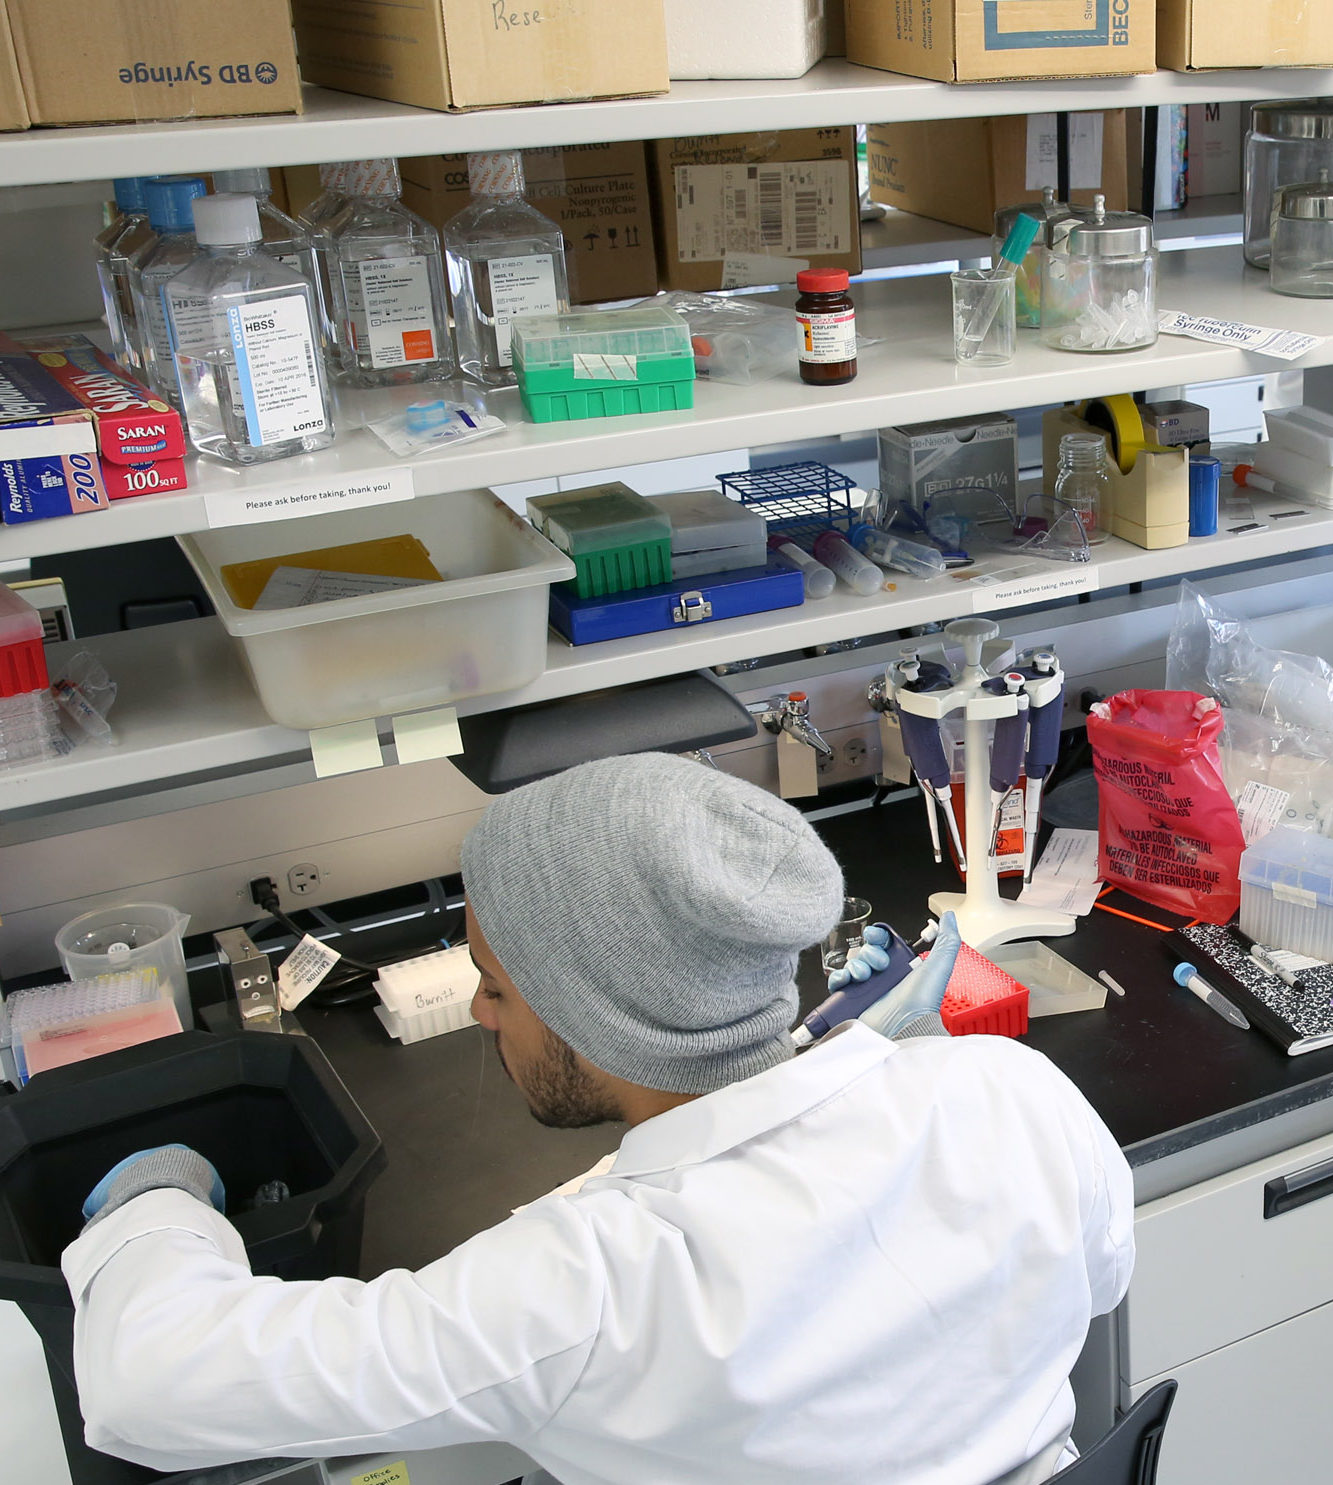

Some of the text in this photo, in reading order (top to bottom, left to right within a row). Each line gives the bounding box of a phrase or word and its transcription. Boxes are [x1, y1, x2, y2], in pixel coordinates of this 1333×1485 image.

[119, 60, 252, 87] BD Syringe
[871, 154, 898, 176] NUNC
[566, 183, 606, 196] Culture
[607, 181, 635, 192] Plate
[569, 193, 637, 208] Nonpyrogenic
[245, 319, 276, 333] HBSS
[1173, 319, 1252, 342] Syringe Only
[69, 372, 149, 413] SARAN
[117, 424, 166, 441] SARAN
[10, 462, 24, 514] Reynolds
[68, 453, 101, 506] 200
[123, 470, 160, 491] 100
[246, 482, 392, 510] Please ask before taking, thank you!
[995, 591, 1012, 599] Please
[1023, 586, 1040, 595] before
[1041, 583, 1058, 592] taking,
[1175, 797, 1194, 808] QUE
[1140, 843, 1150, 855] BE
[1151, 844, 1199, 866] AUTOCLAVED
[1174, 836, 1213, 855] MATERIAL
[1105, 845, 1220, 884] MATERIALES INFECCIOSOS QUE
[1109, 860, 1213, 895] DEBEN SER ESTERILIZADOS
[305, 960, 330, 984] CAUTION:
[363, 1469, 392, 1482] Office
